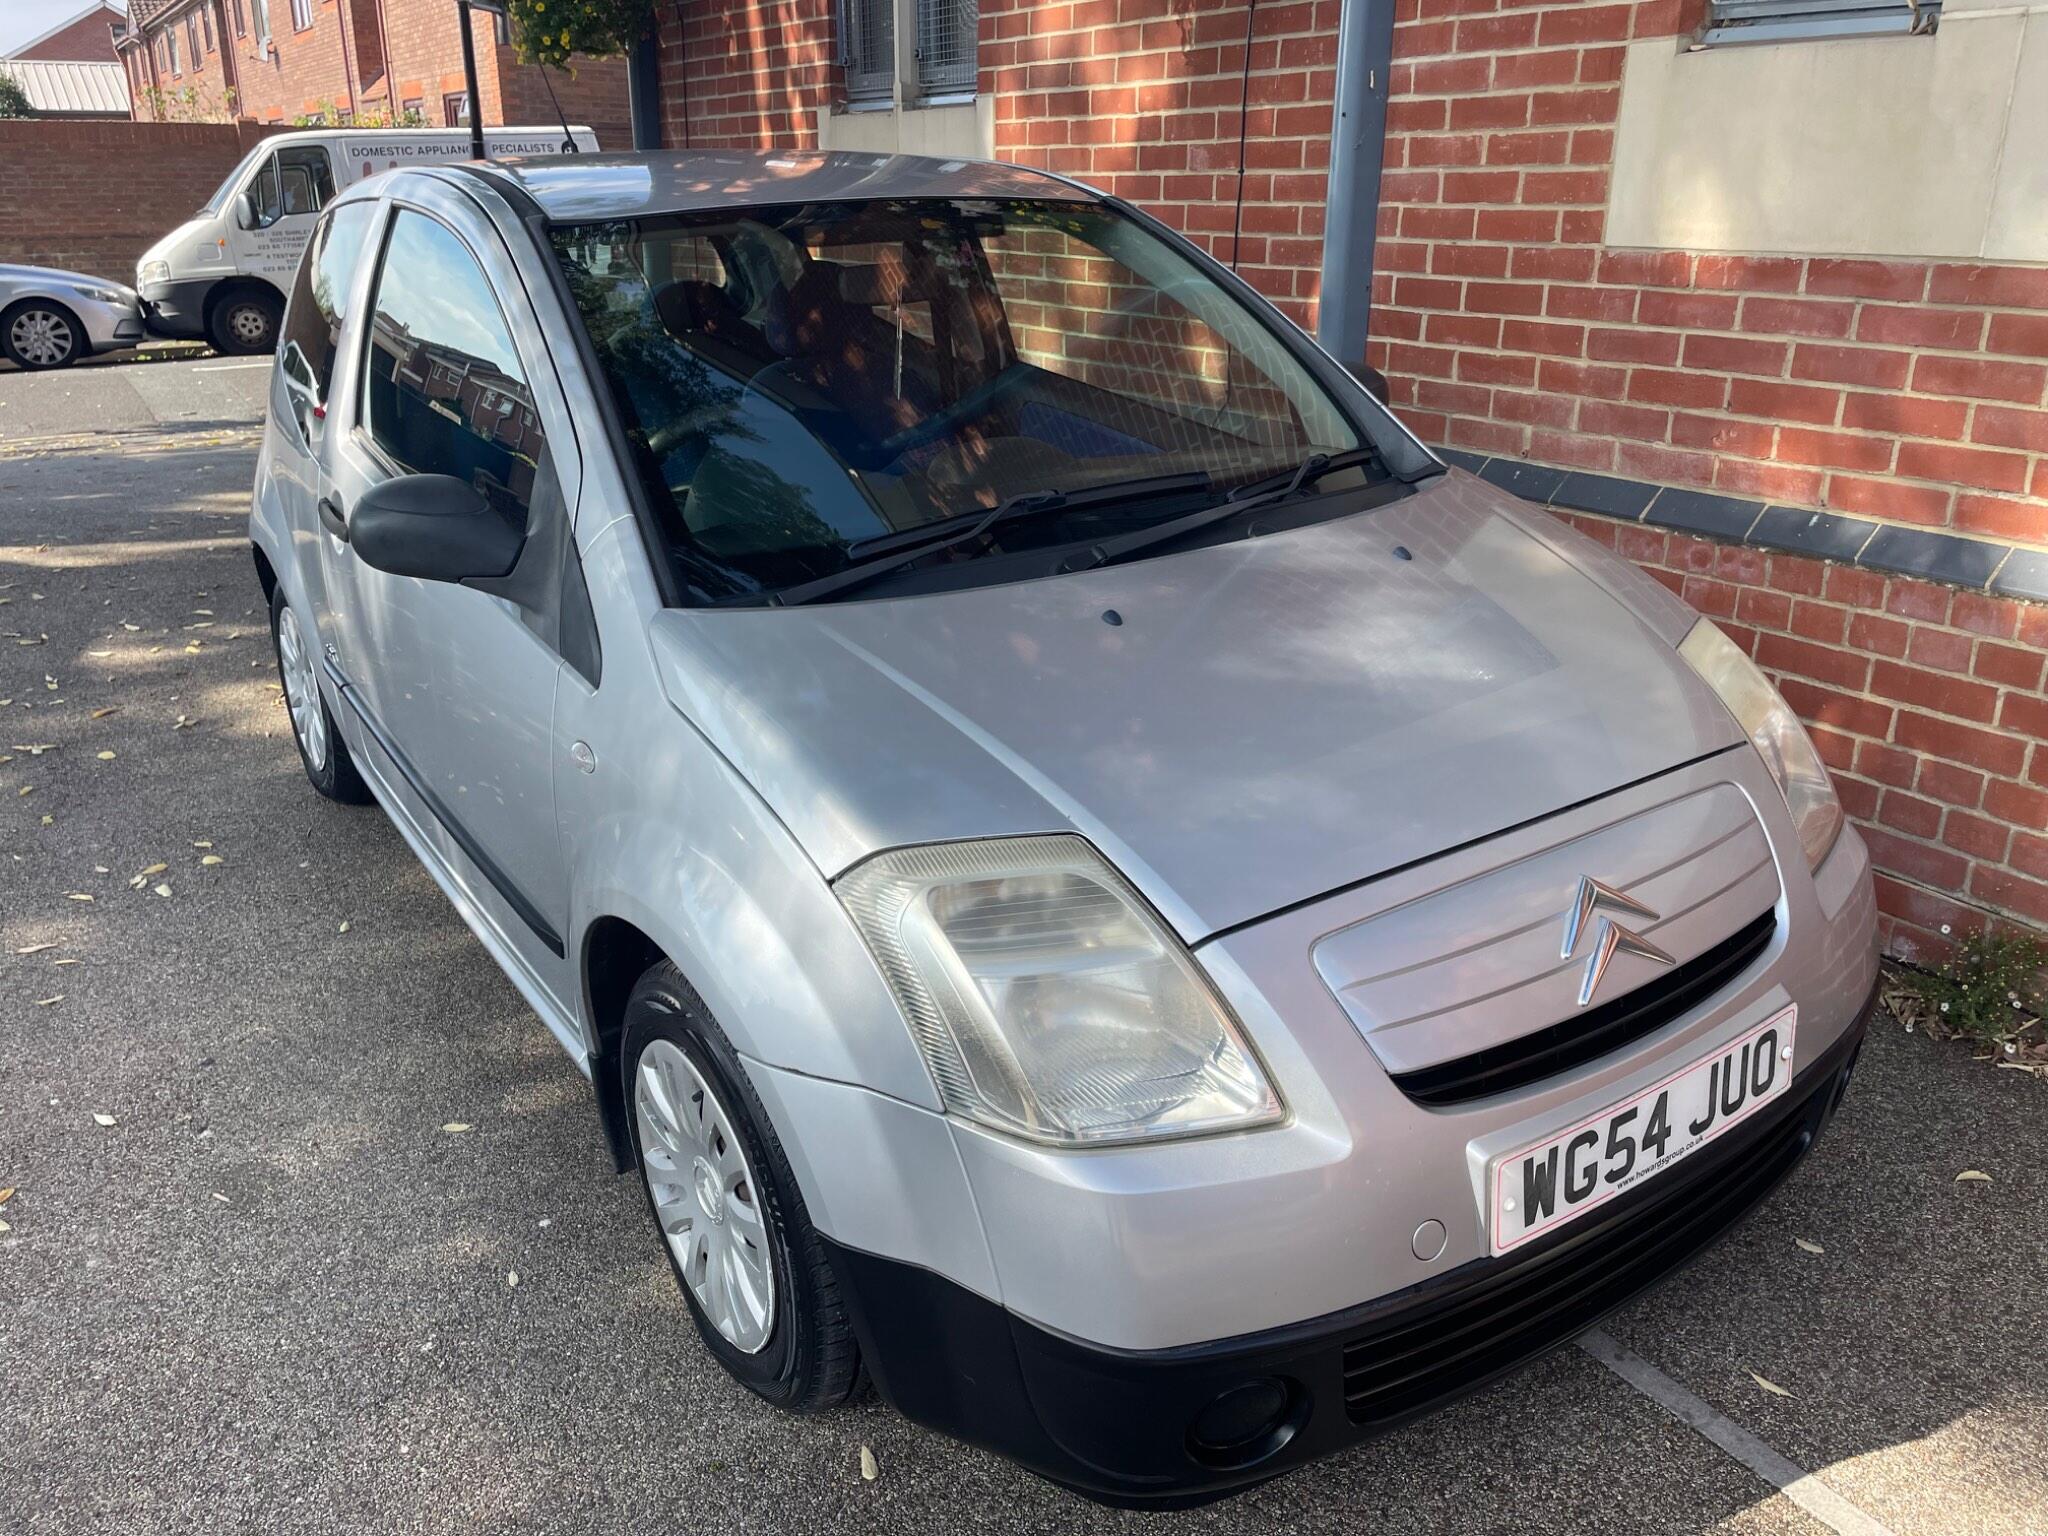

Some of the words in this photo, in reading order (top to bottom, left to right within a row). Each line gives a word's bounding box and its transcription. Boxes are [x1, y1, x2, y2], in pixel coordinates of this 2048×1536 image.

[352, 145, 413, 157] DOMESTIC
[492, 144, 554, 153] PECIALISTS
[1523, 1090, 1671, 1228] WG54
[1689, 1028, 1778, 1136] JUO
[1617, 1135, 1704, 1189] www.howardsgroup.co.uk
